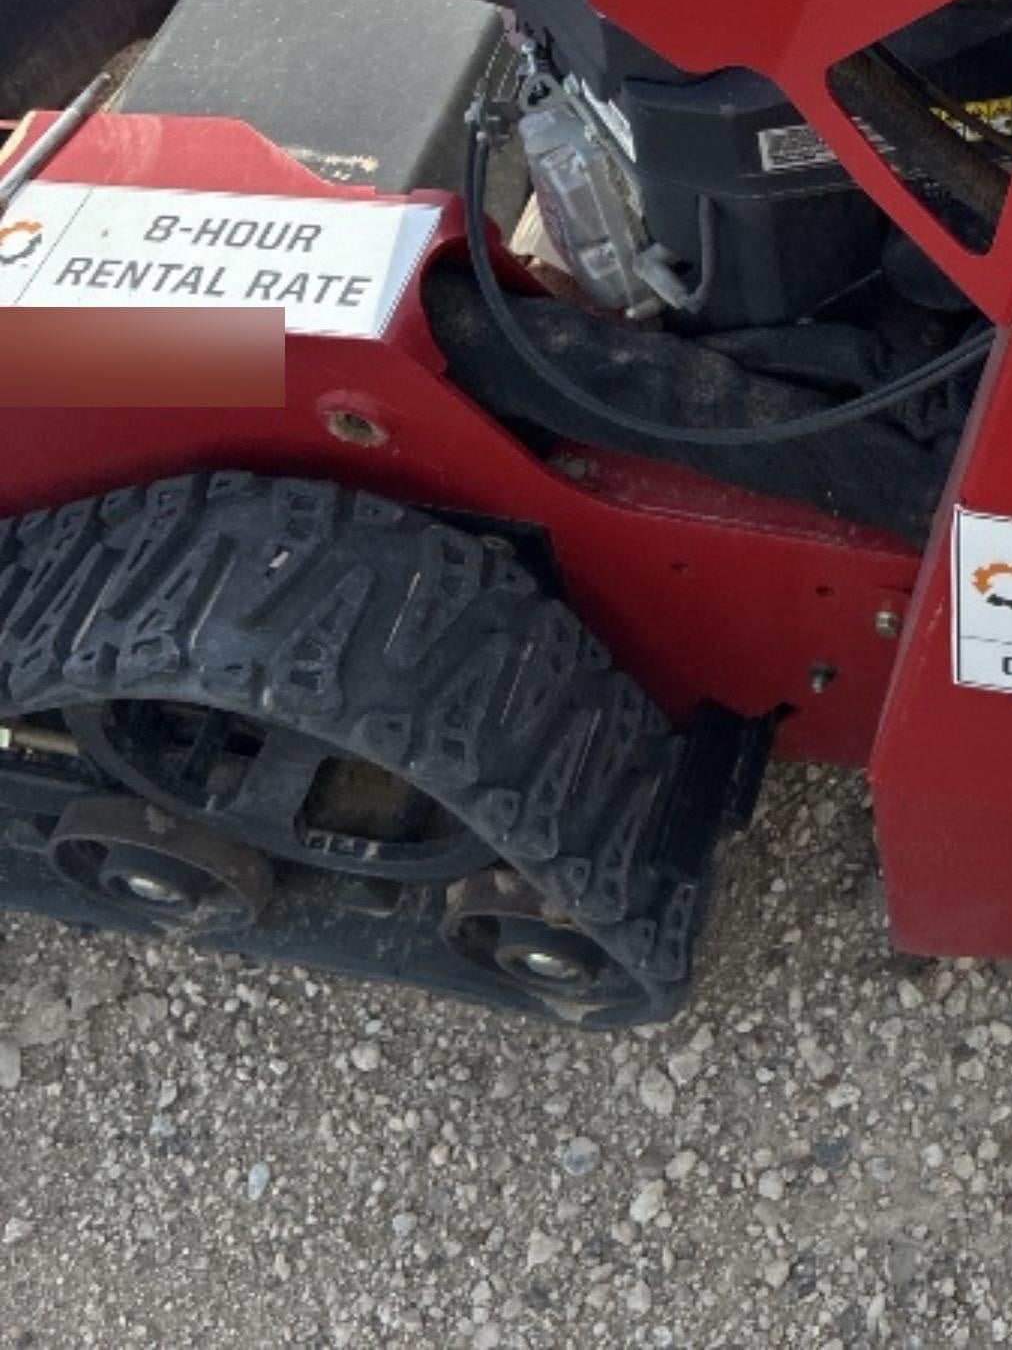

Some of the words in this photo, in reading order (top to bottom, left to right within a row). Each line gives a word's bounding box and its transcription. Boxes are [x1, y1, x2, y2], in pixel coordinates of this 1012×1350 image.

[143, 215, 323, 252] 8-HOUR
[53, 256, 227, 298] RENTAL
[243, 270, 373, 307] RATE
